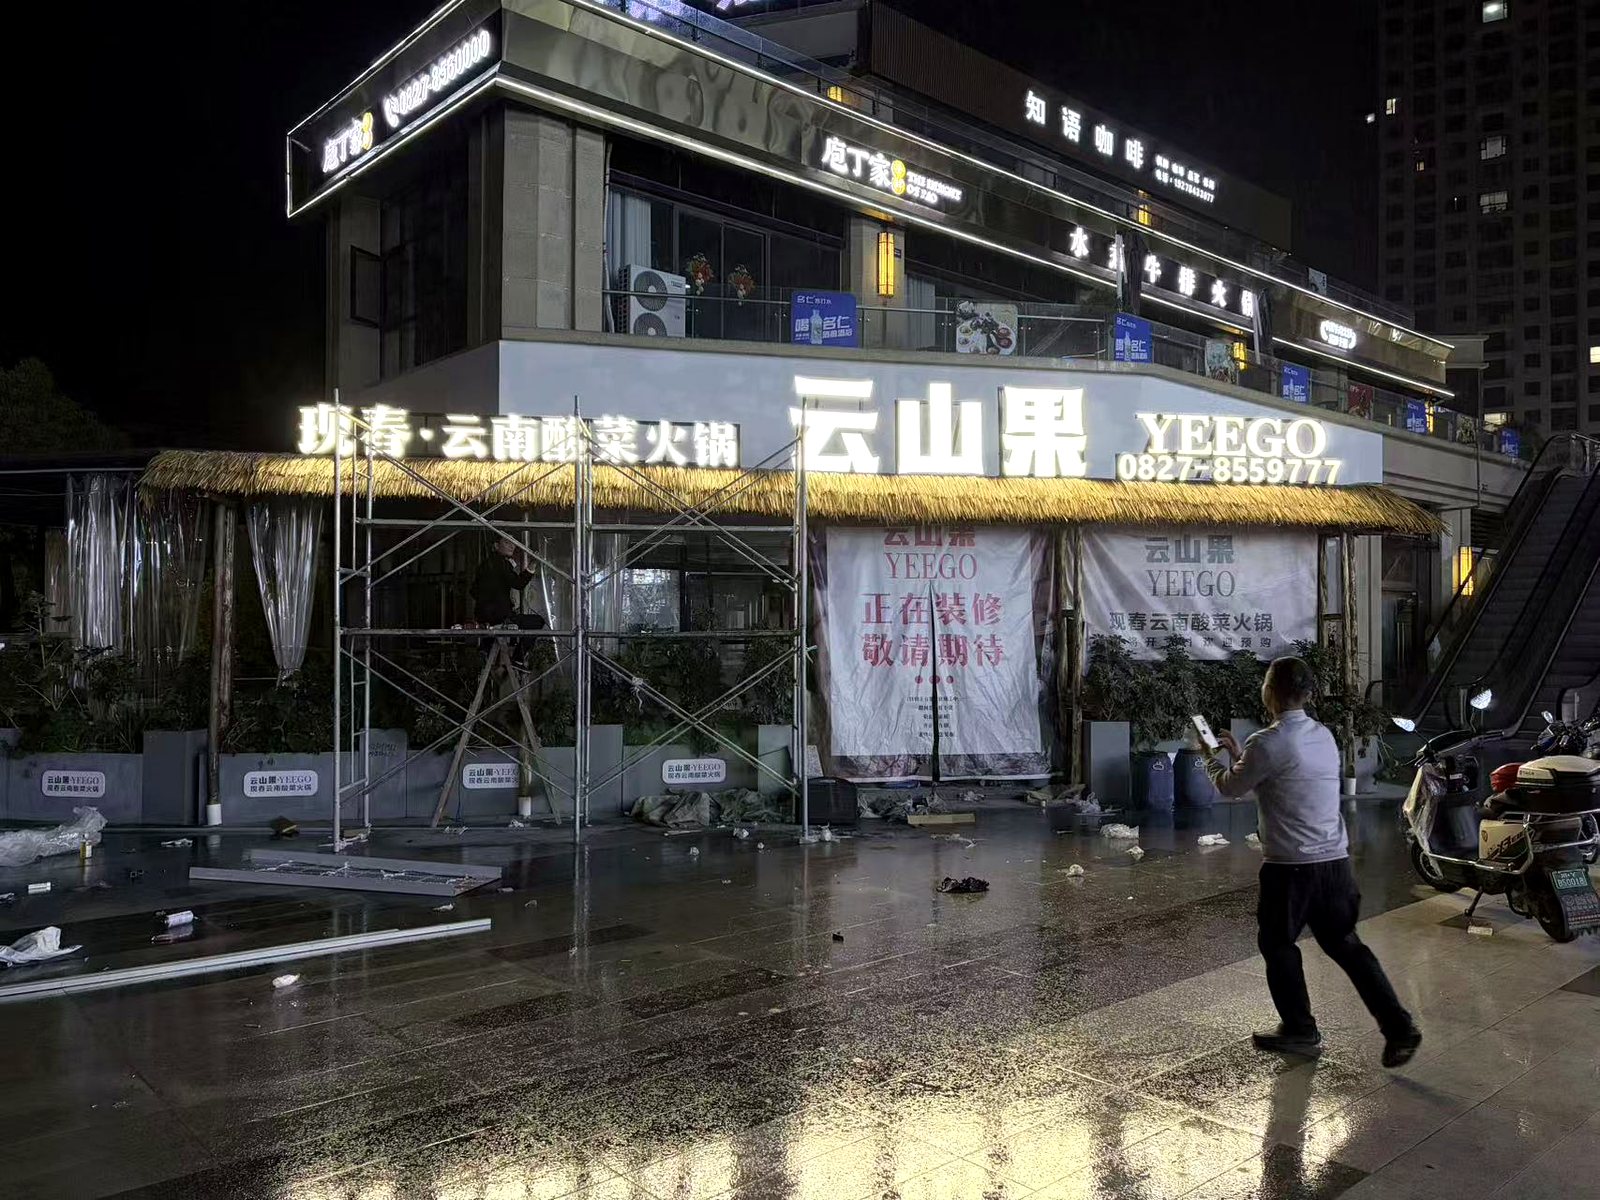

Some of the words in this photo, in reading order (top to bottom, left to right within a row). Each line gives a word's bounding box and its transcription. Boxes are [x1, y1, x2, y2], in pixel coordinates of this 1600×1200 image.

[1025, 90, 1144, 169] 知语咖啡
[822, 137, 891, 187] 庖丁家
[789, 376, 1086, 477] 云山果
[1136, 412, 1327, 460] YEEGO
[1119, 452, 1342, 485] 0827-8559777
[1145, 534, 1234, 564] 云山果
[885, 553, 978, 580] YEEGO
[1146, 569, 1236, 597] YEEGO
[861, 592, 1004, 626] 正在装修
[861, 633, 1004, 668] 敬请期待
